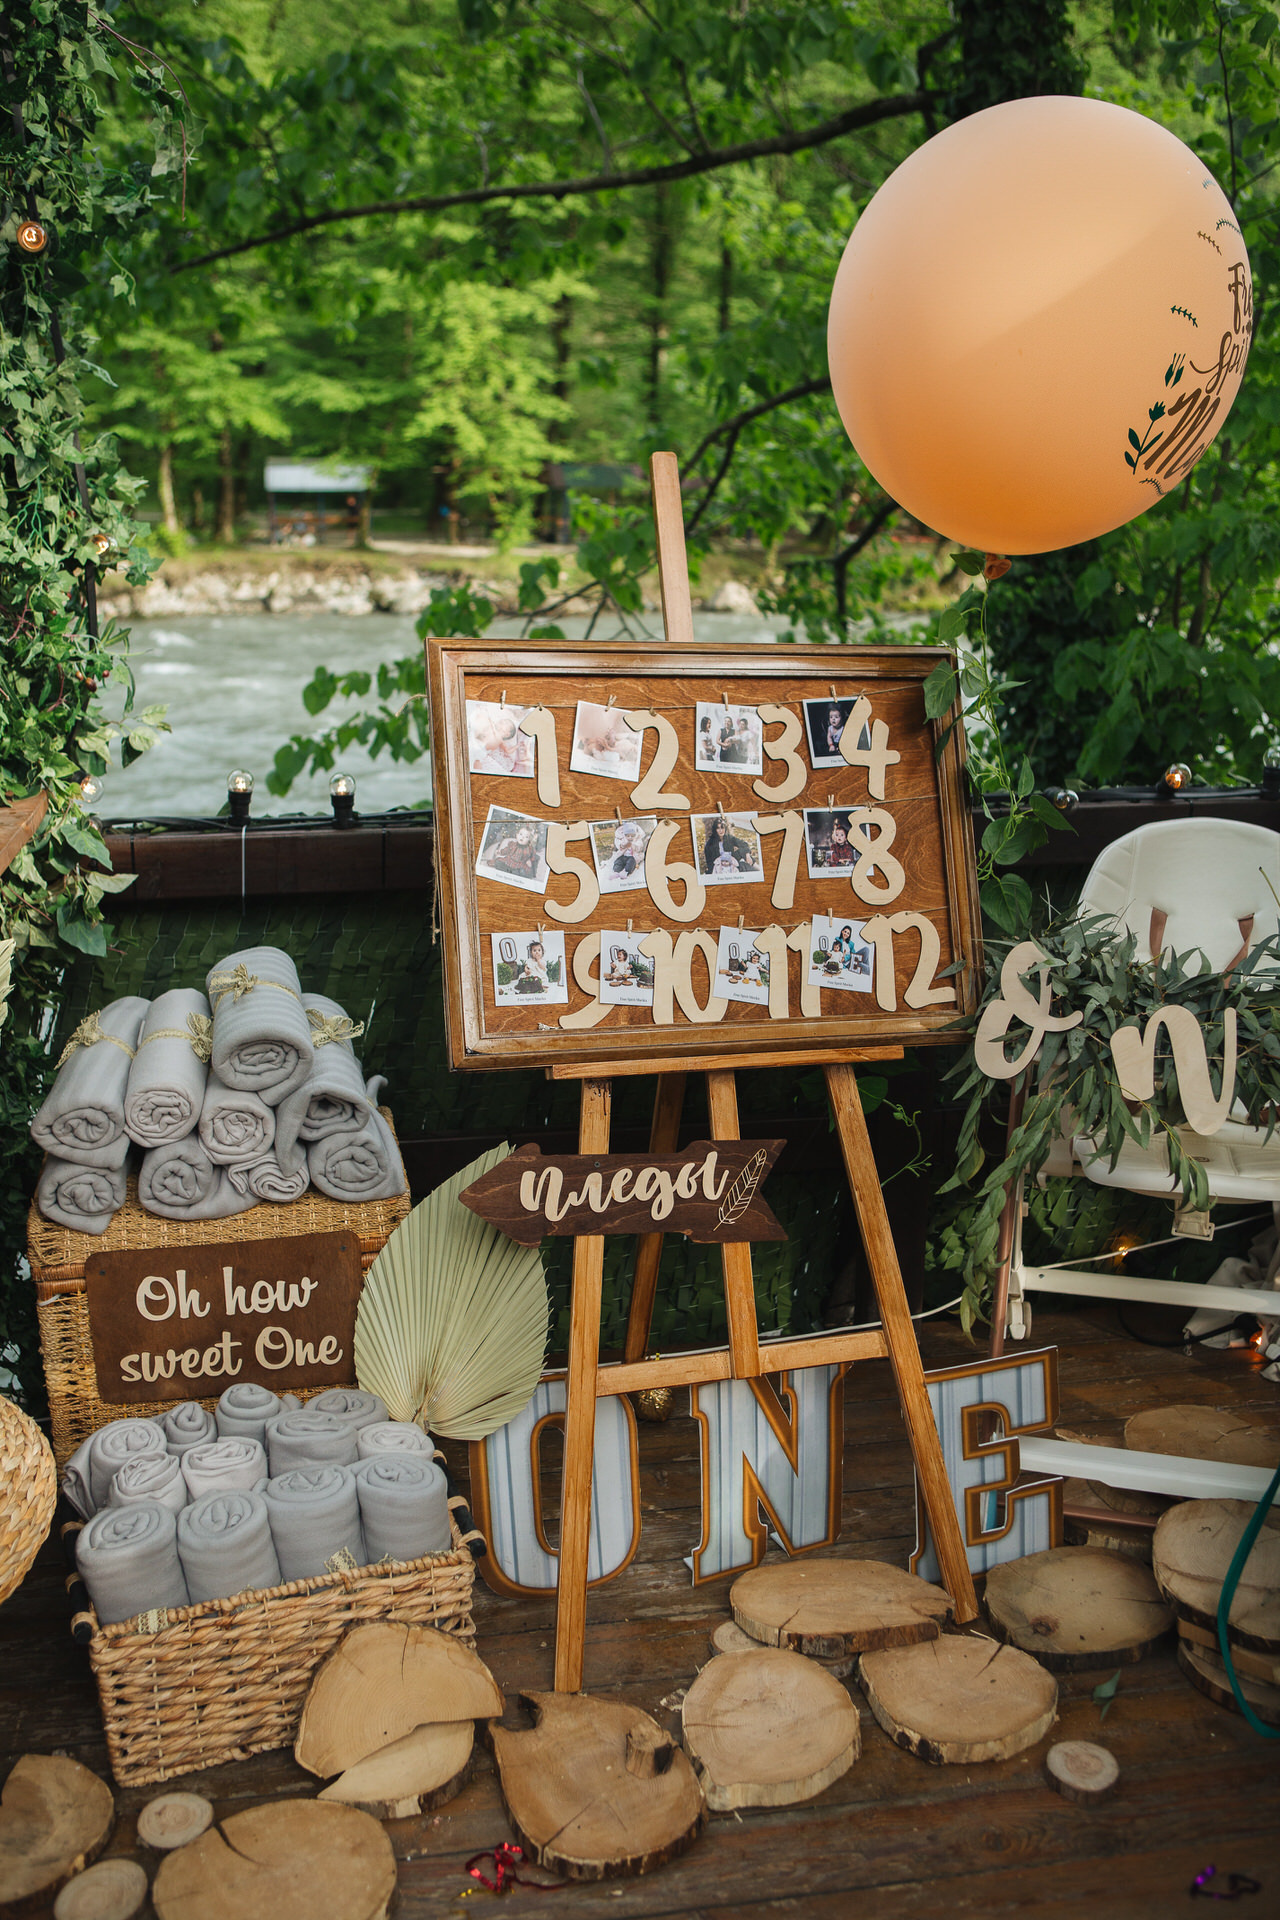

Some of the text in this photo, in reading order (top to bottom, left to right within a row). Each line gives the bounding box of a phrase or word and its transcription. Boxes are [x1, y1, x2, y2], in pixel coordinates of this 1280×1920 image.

[519, 703, 560, 808] 1
[622, 707, 691, 810] 2
[752, 703, 808, 803] 3
[839, 695, 901, 801] 4
[543, 820, 600, 923] 5
[645, 819, 706, 923] 6
[751, 809, 805, 910] 7
[847, 802, 906, 905] 8
[637, 927, 730, 1024] 10
[753, 921, 822, 1018] 11
[860, 910, 957, 1012] 12
[135, 1266, 318, 1322] Oh how
[119, 1325, 343, 1383] sweet One
[469, 1346, 1064, 1600] ONE
